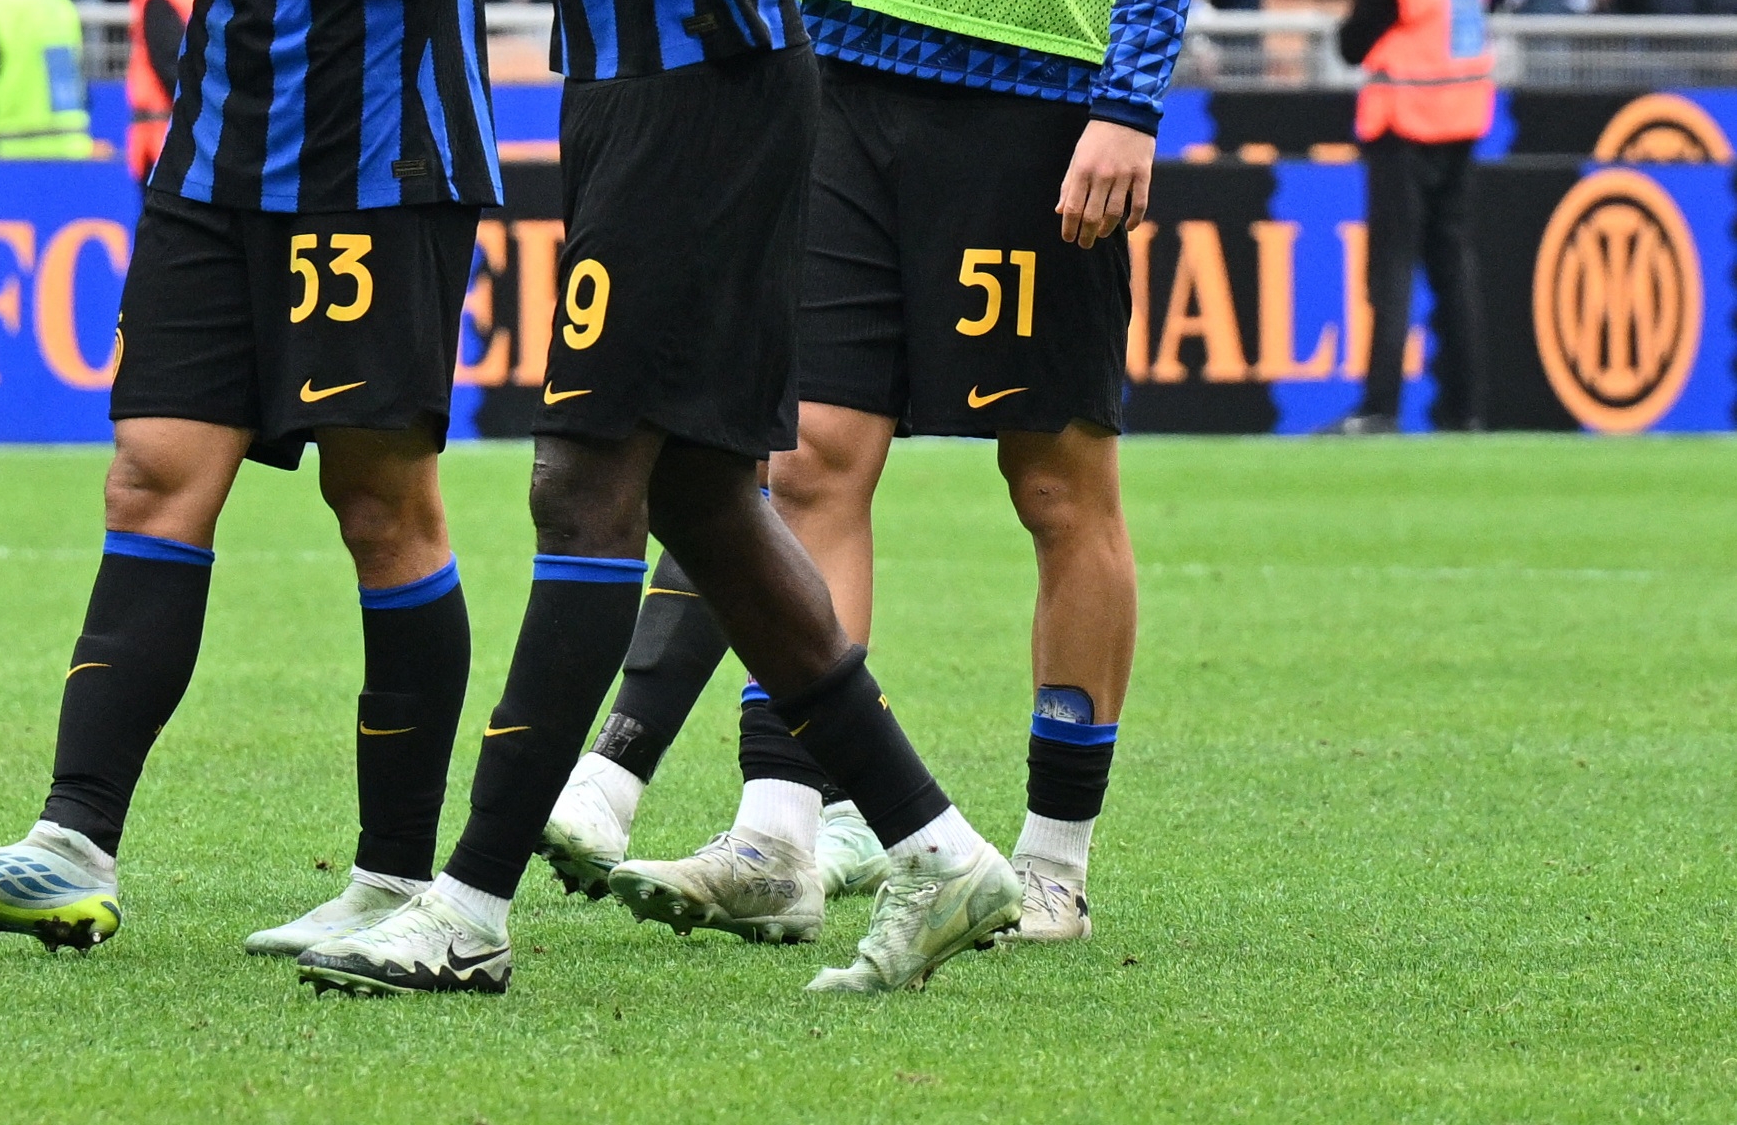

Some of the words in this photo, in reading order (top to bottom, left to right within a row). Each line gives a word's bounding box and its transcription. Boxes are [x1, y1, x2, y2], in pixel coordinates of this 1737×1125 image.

[289, 233, 374, 323] 53
[563, 258, 611, 350] 9
[955, 248, 1036, 337] 51
